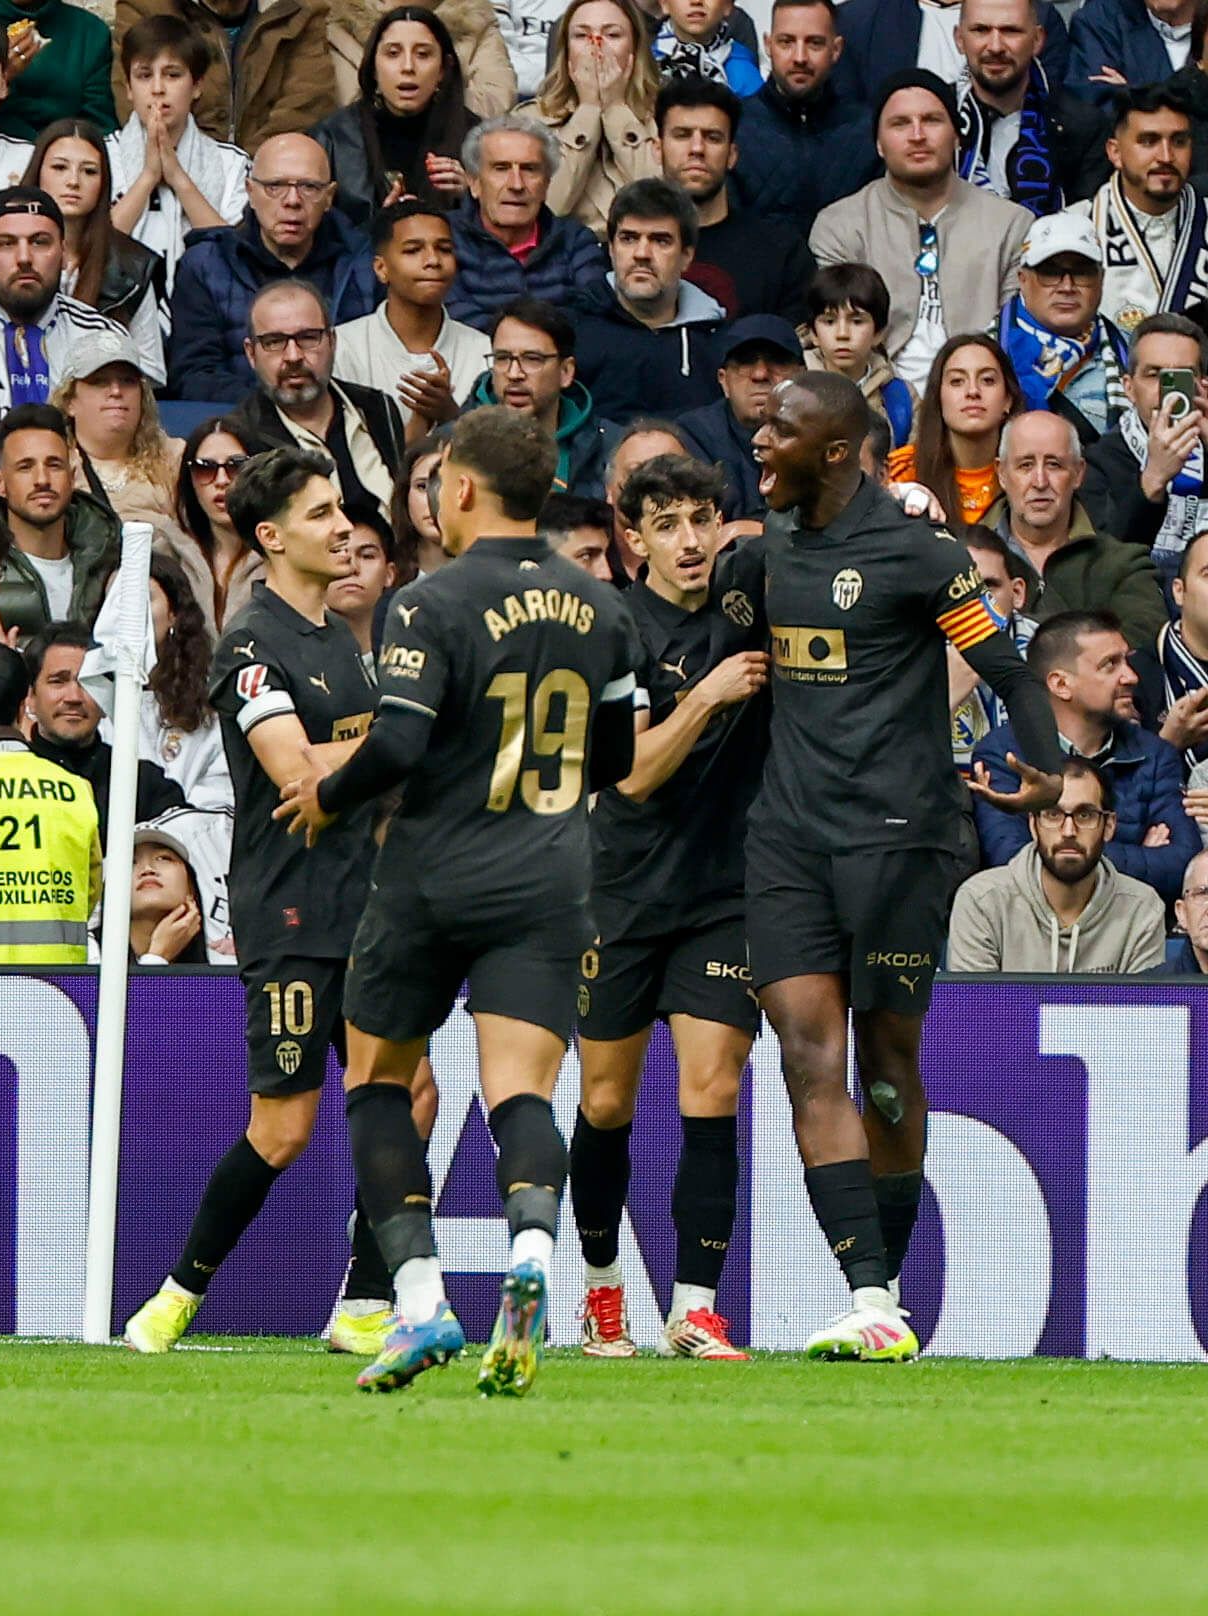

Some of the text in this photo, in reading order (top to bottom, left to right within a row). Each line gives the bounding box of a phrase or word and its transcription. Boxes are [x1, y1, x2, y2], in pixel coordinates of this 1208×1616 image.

[483, 588, 595, 642] AARONS
[817, 671, 848, 684] Group
[486, 668, 590, 816] 19
[262, 980, 313, 1036] 10
